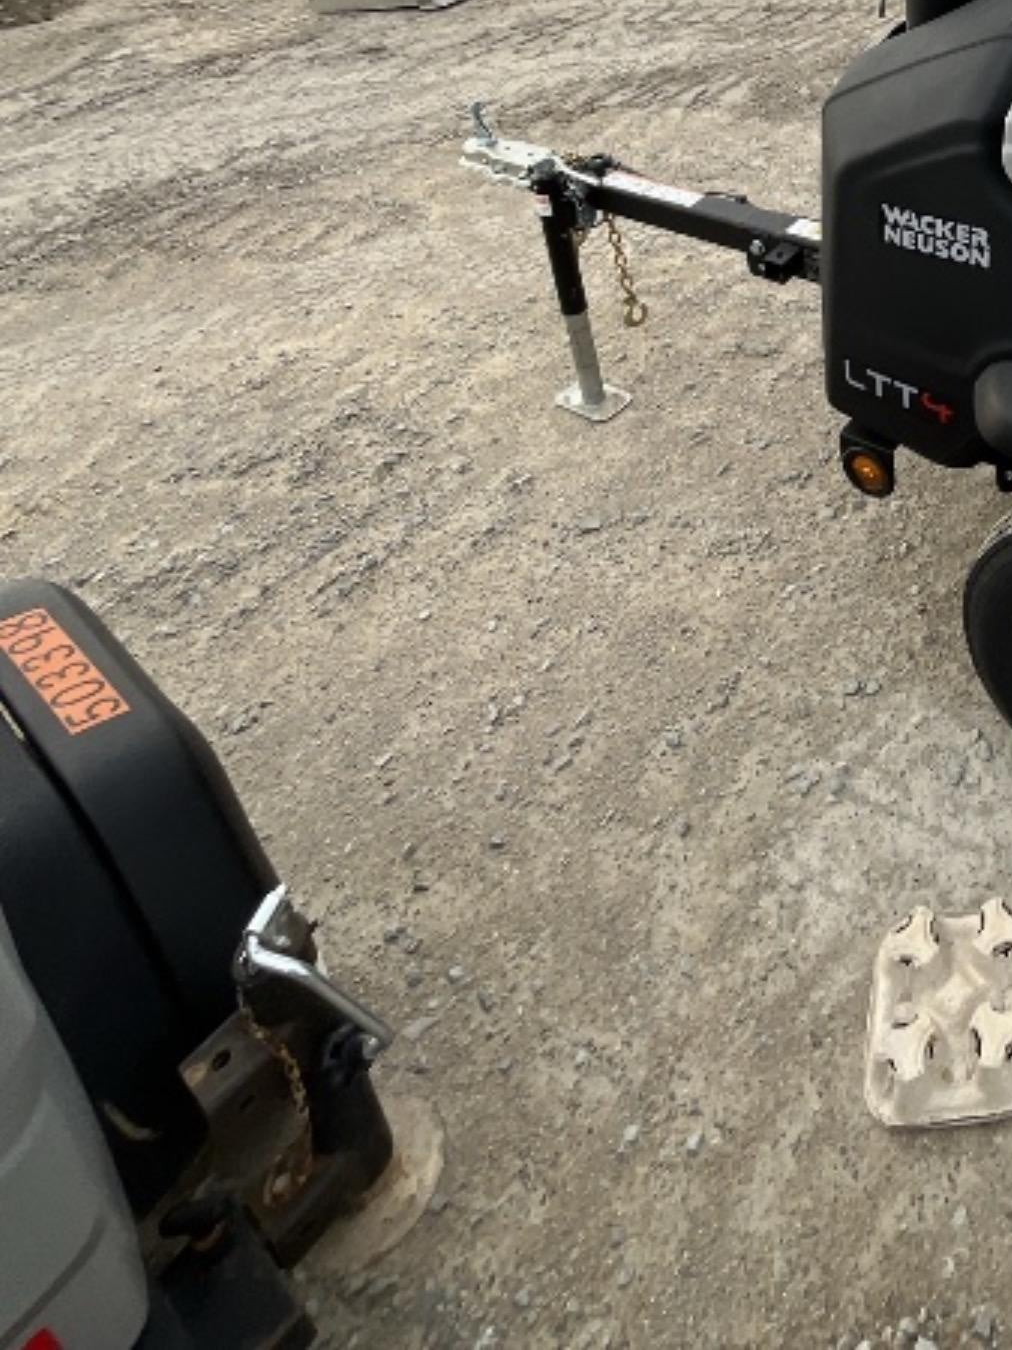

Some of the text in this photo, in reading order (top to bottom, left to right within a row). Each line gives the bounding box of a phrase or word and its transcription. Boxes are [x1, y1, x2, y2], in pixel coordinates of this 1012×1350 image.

[881, 203, 990, 250] WACKER
[884, 224, 991, 268] NEUSON
[844, 359, 952, 425] LTT4
